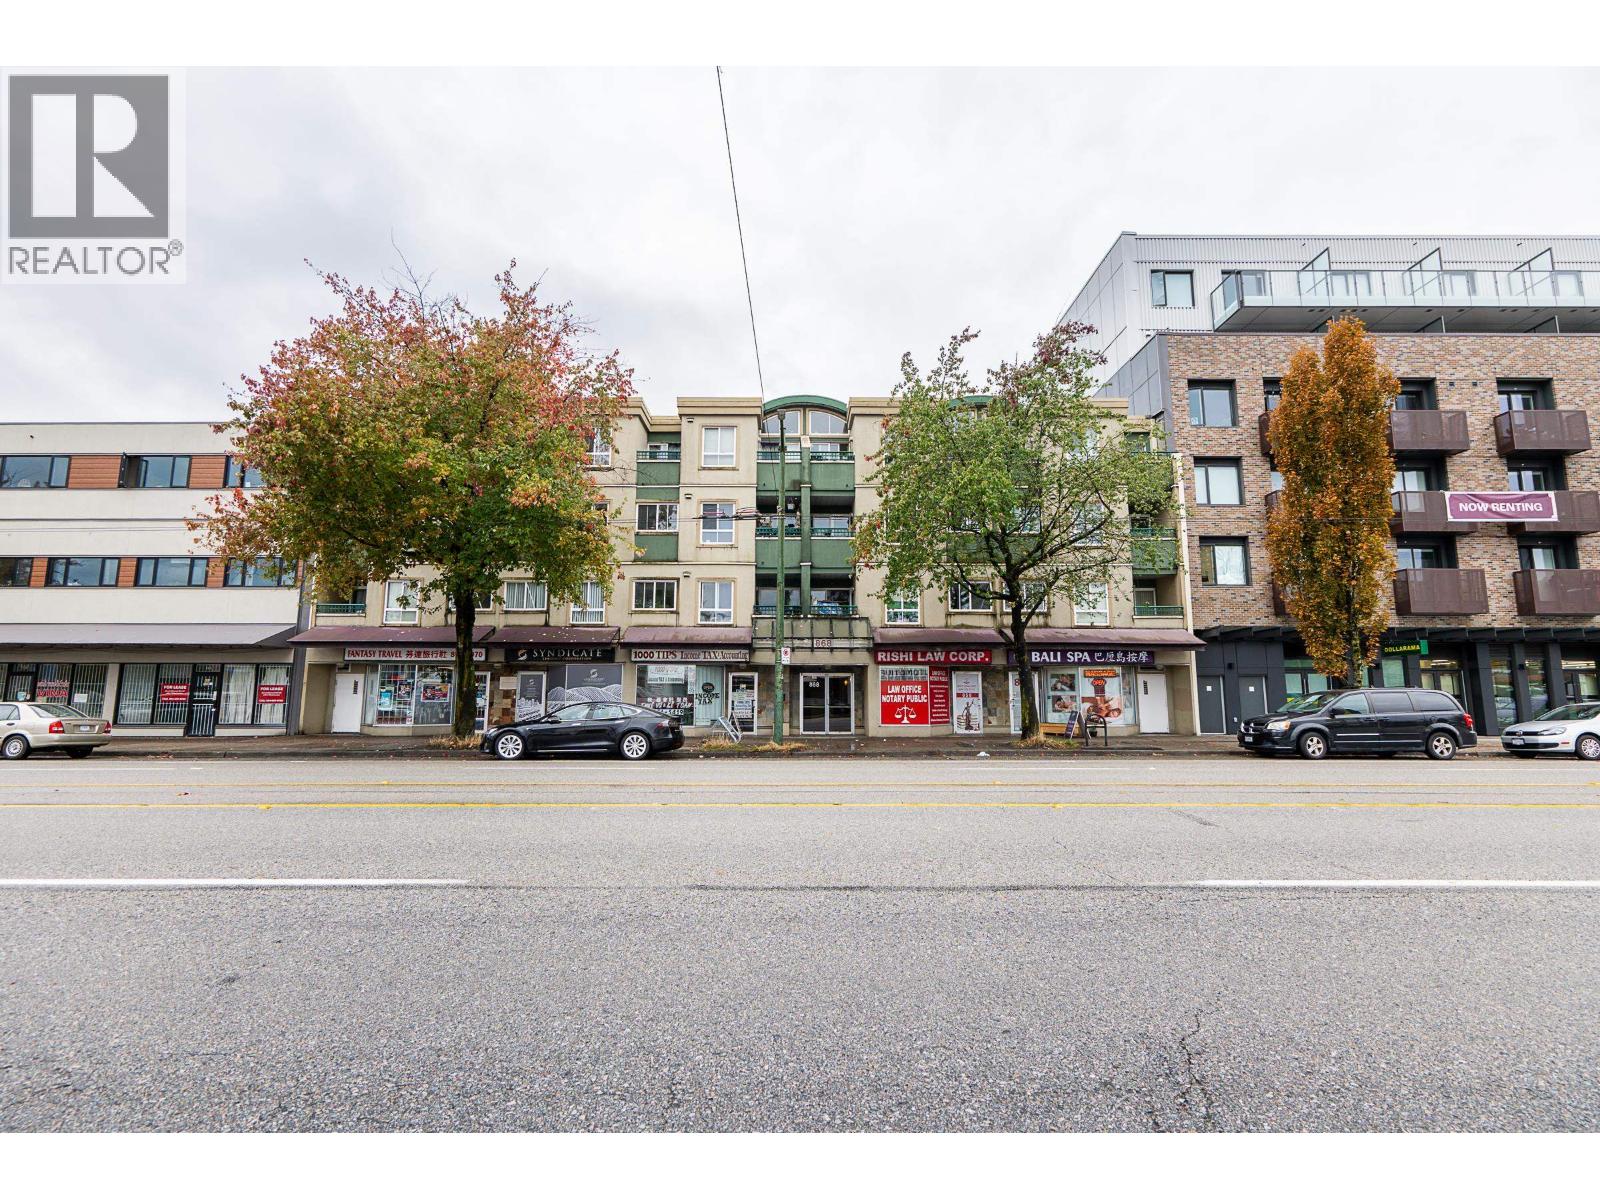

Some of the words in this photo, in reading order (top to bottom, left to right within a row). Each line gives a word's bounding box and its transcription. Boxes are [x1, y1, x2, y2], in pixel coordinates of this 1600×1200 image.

[1459, 502, 1489, 512] NOW
[1491, 502, 1543, 512] RENTING
[815, 639, 832, 648] 868
[532, 648, 602, 657] SYNDICATE
[1384, 644, 1421, 653] DOLLARAMA
[347, 649, 377, 658] FANTASY
[378, 649, 403, 658] TRAVEL
[633, 650, 655, 659] 1000
[656, 650, 678, 660] TIPS
[702, 650, 718, 660] TAX
[877, 651, 913, 662] RISHI
[917, 651, 945, 662] LAW
[949, 651, 989, 662] CORP.
[1031, 651, 1061, 662] BALI
[1066, 651, 1091, 662] SPA
[887, 685, 901, 693] LAW
[901, 685, 922, 693] OFFICE
[881, 694, 905, 703] NOTARY
[906, 694, 928, 703] PUBLIC
